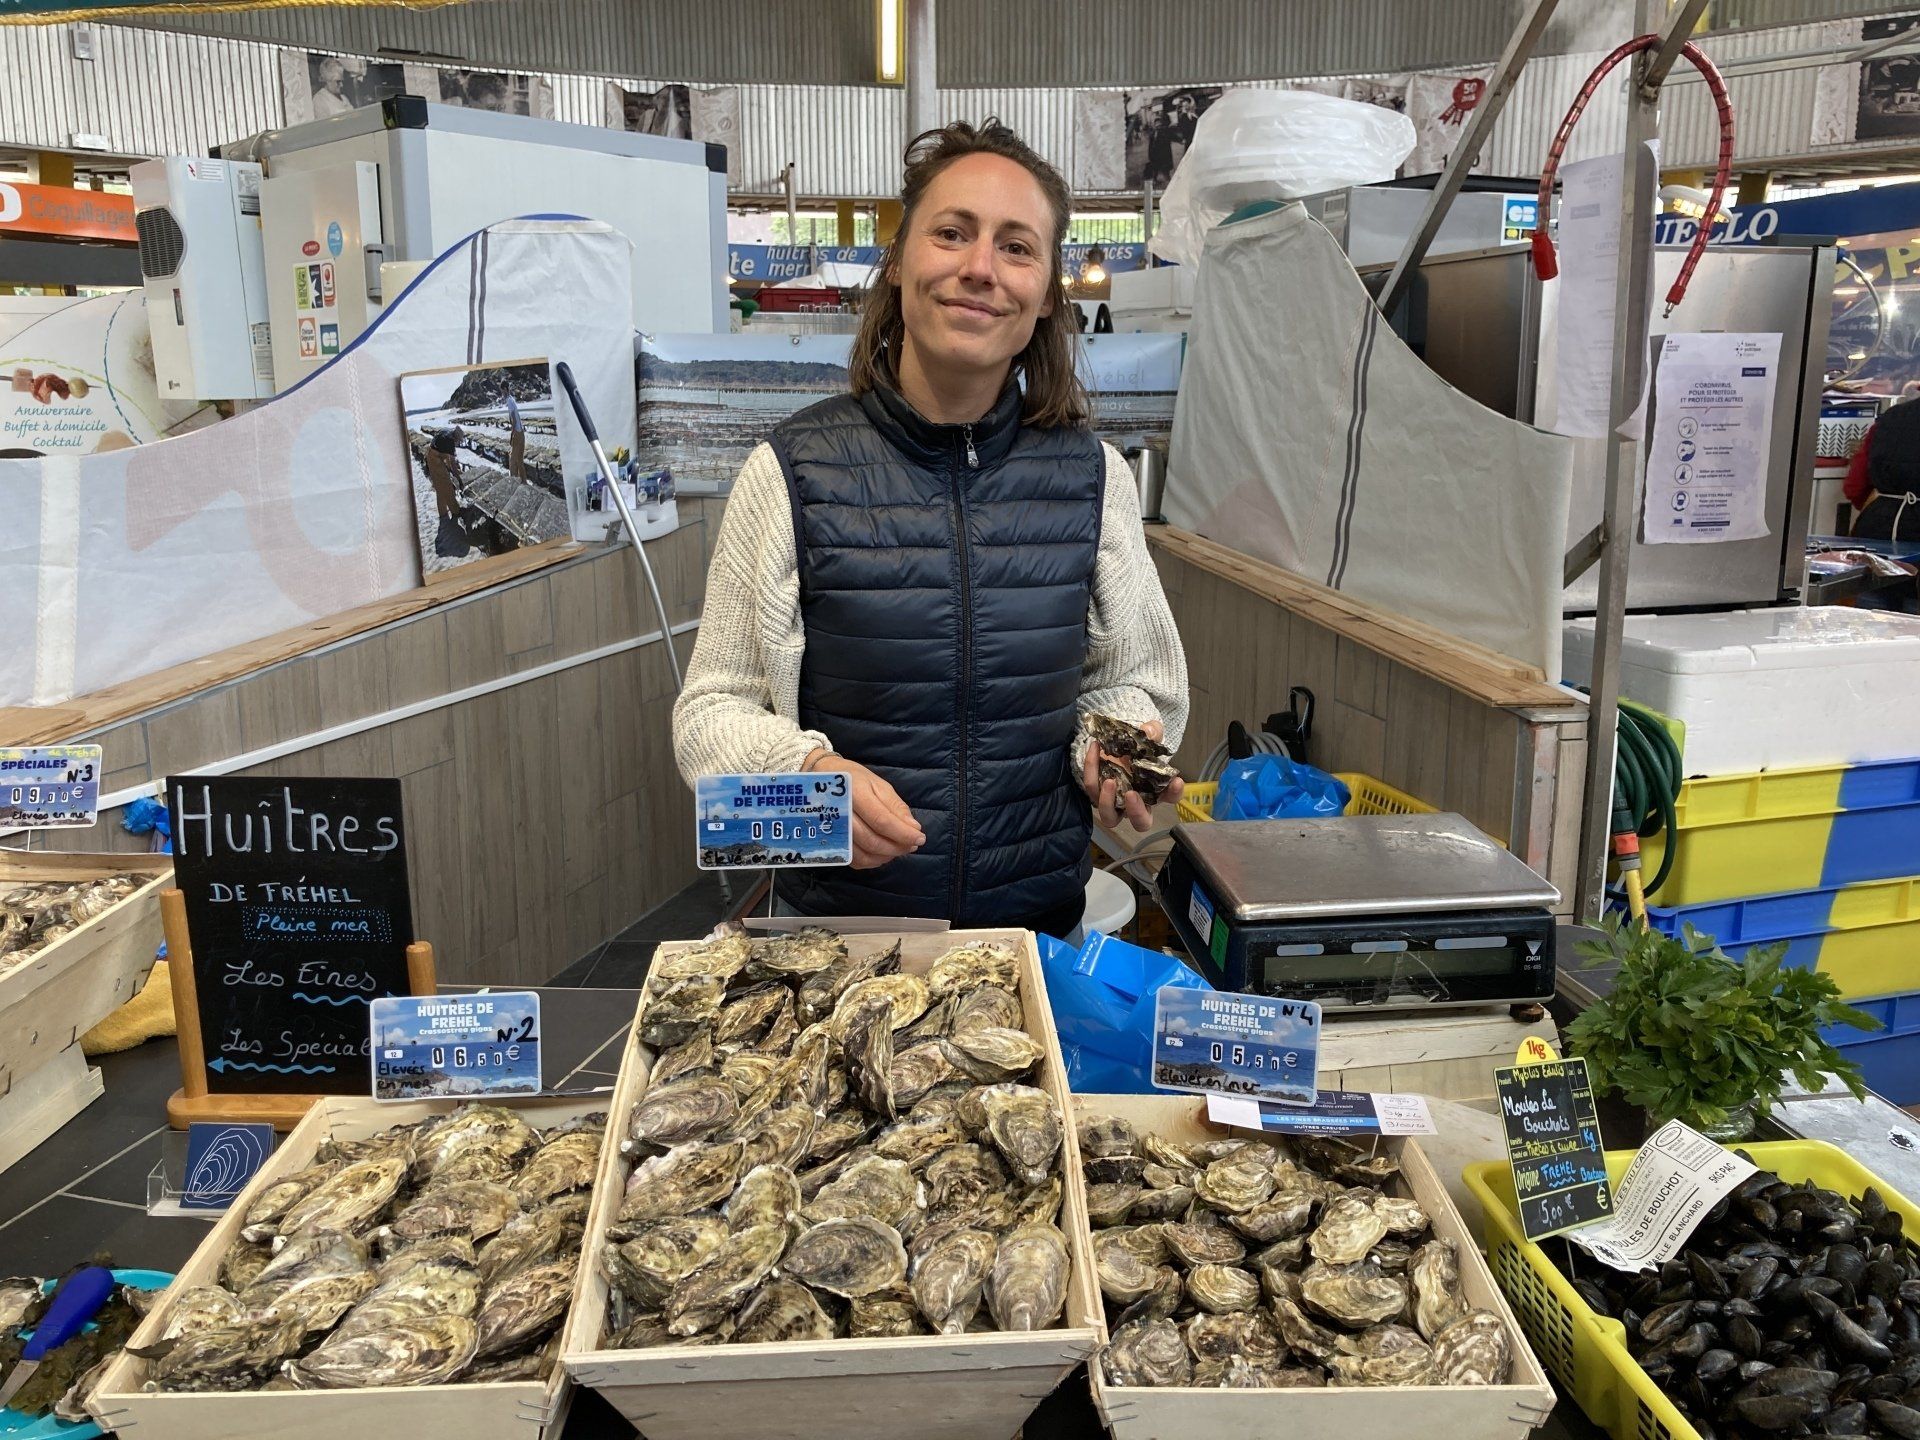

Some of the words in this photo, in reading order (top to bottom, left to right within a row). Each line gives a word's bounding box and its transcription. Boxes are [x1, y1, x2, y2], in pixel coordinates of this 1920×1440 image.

[15, 404, 93, 416] Anniversaire
[4, 420, 40, 439] Buffet
[43, 420, 52, 431] à
[54, 420, 108, 432] domicile
[32, 436, 83, 447] Cocktail
[1, 757, 68, 770] SPÉCIALES
[741, 784, 804, 796] HUITRES
[733, 797, 753, 808] DE
[757, 796, 811, 807] FREHEL
[176, 784, 399, 857] Huîtres
[209, 883, 248, 902] DE
[257, 875, 362, 902] FRÉHEL
[256, 913, 317, 932] Pleine
[223, 960, 285, 987] Les
[417, 1004, 473, 1017] HUITRES
[476, 1002, 494, 1014] DE
[1201, 999, 1256, 1016] HUITRES
[1258, 1005, 1277, 1019] DE
[431, 1016, 481, 1029] FREHEL
[1213, 1014, 1262, 1029] FREHEL
[419, 1027, 469, 1035] Crassostrea
[470, 1026, 493, 1034] gigas
[220, 1028, 264, 1054] Les
[1526, 1039, 1547, 1060] 1kg
[377, 1079, 397, 1090] en
[1228, 1081, 1261, 1092] mer
[1626, 1170, 1636, 1186] DU
[1635, 1149, 1648, 1169] CAP
[1640, 1214, 1653, 1231] DE
[1647, 1171, 1684, 1216] BOUCHOT
[1668, 1199, 1704, 1242] BLANCHARD
